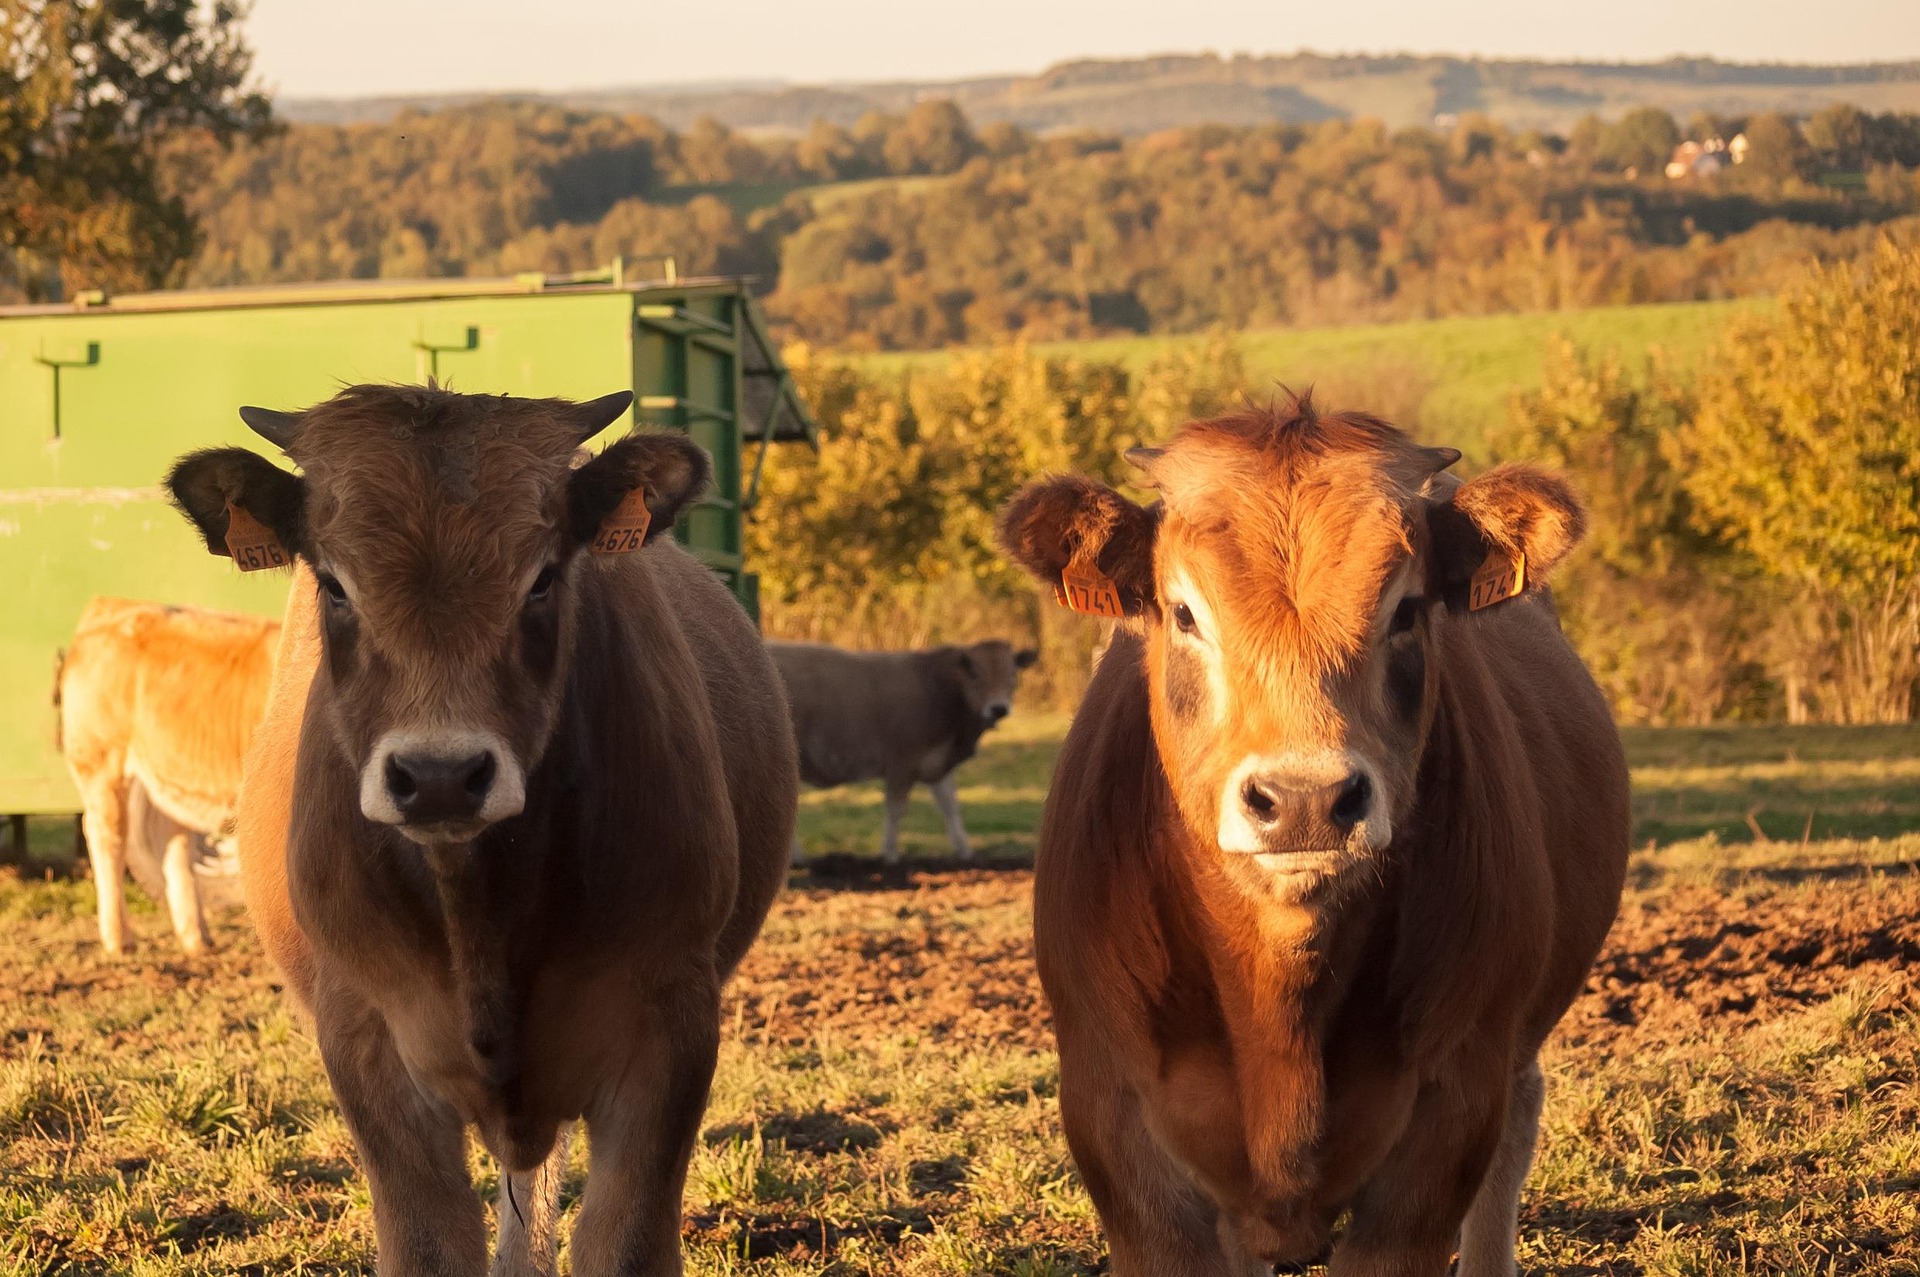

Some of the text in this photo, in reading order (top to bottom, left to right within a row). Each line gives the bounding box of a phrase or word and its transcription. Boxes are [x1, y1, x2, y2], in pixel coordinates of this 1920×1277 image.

[595, 529, 642, 550] 4676
[237, 544, 282, 567] 4676
[1070, 585, 1116, 614] 1741
[1473, 572, 1516, 607] 1741
